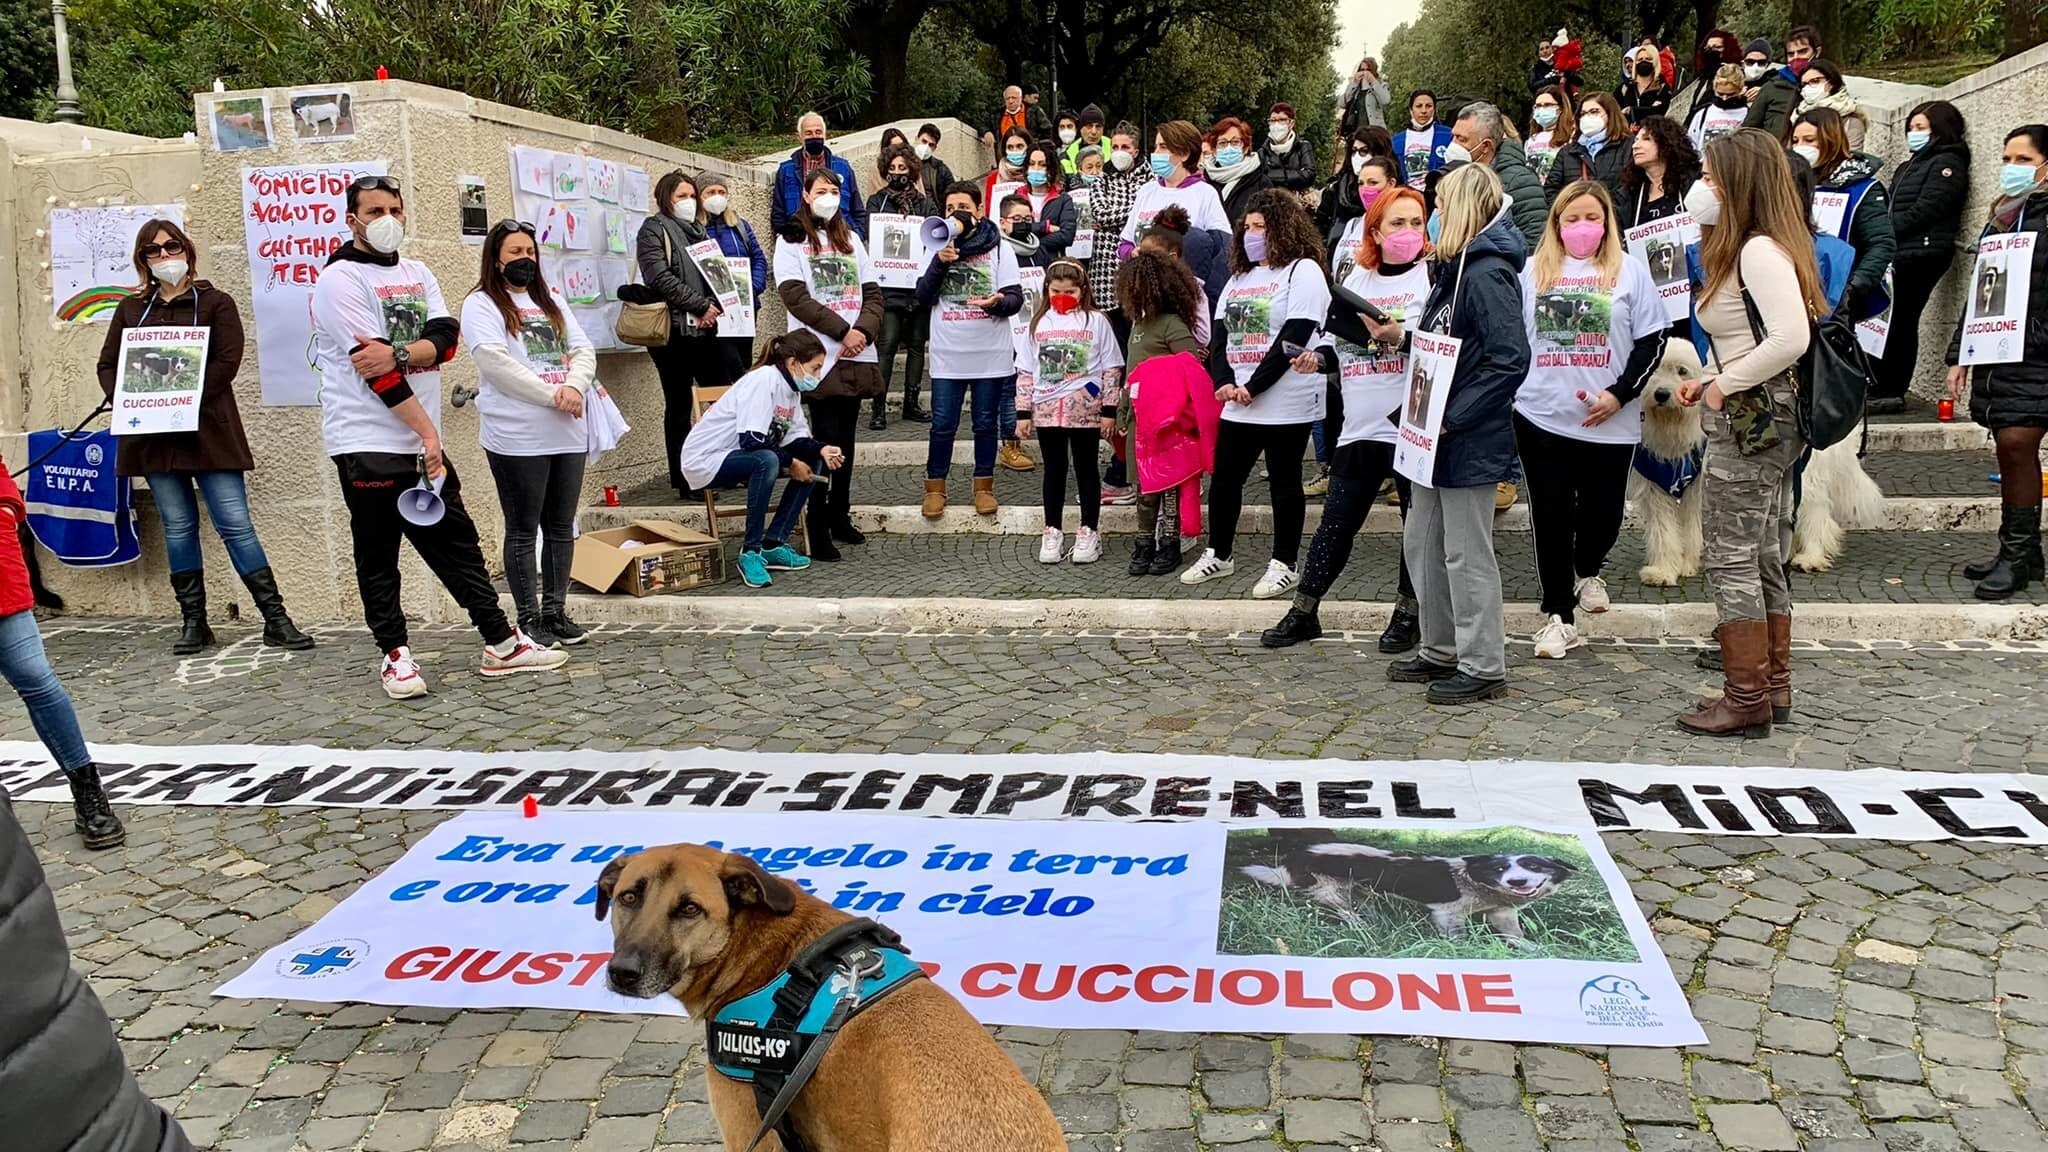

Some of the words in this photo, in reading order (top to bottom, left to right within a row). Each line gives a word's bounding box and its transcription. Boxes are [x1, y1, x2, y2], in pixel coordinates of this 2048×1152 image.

[1821, 197, 1843, 207] PER
[1629, 220, 1674, 241] GIUSTIZIA
[2006, 237, 2030, 250] PER
[873, 260, 919, 270] CUCCIOLONE
[1966, 320, 2018, 335] CUCCIOLONE
[127, 331, 181, 341] GIUSTIZIA
[183, 331, 206, 340] PER
[1576, 333, 1607, 346] AIUTO
[1437, 341, 1457, 358] PER
[122, 396, 193, 408] CUCCIOLONE
[43, 465, 98, 478] VOLONTARIO
[436, 835, 566, 863] Era
[921, 844, 1004, 873] in
[1008, 848, 1188, 876] terra
[389, 879, 441, 903] e
[443, 879, 570, 904] ora
[831, 880, 906, 913] in
[919, 884, 1095, 917] cielo
[960, 961, 1522, 1015] CUCCIOLONE
[1602, 997, 1631, 1005] LEGA
[1590, 1004, 1648, 1012] NAZIONALE
